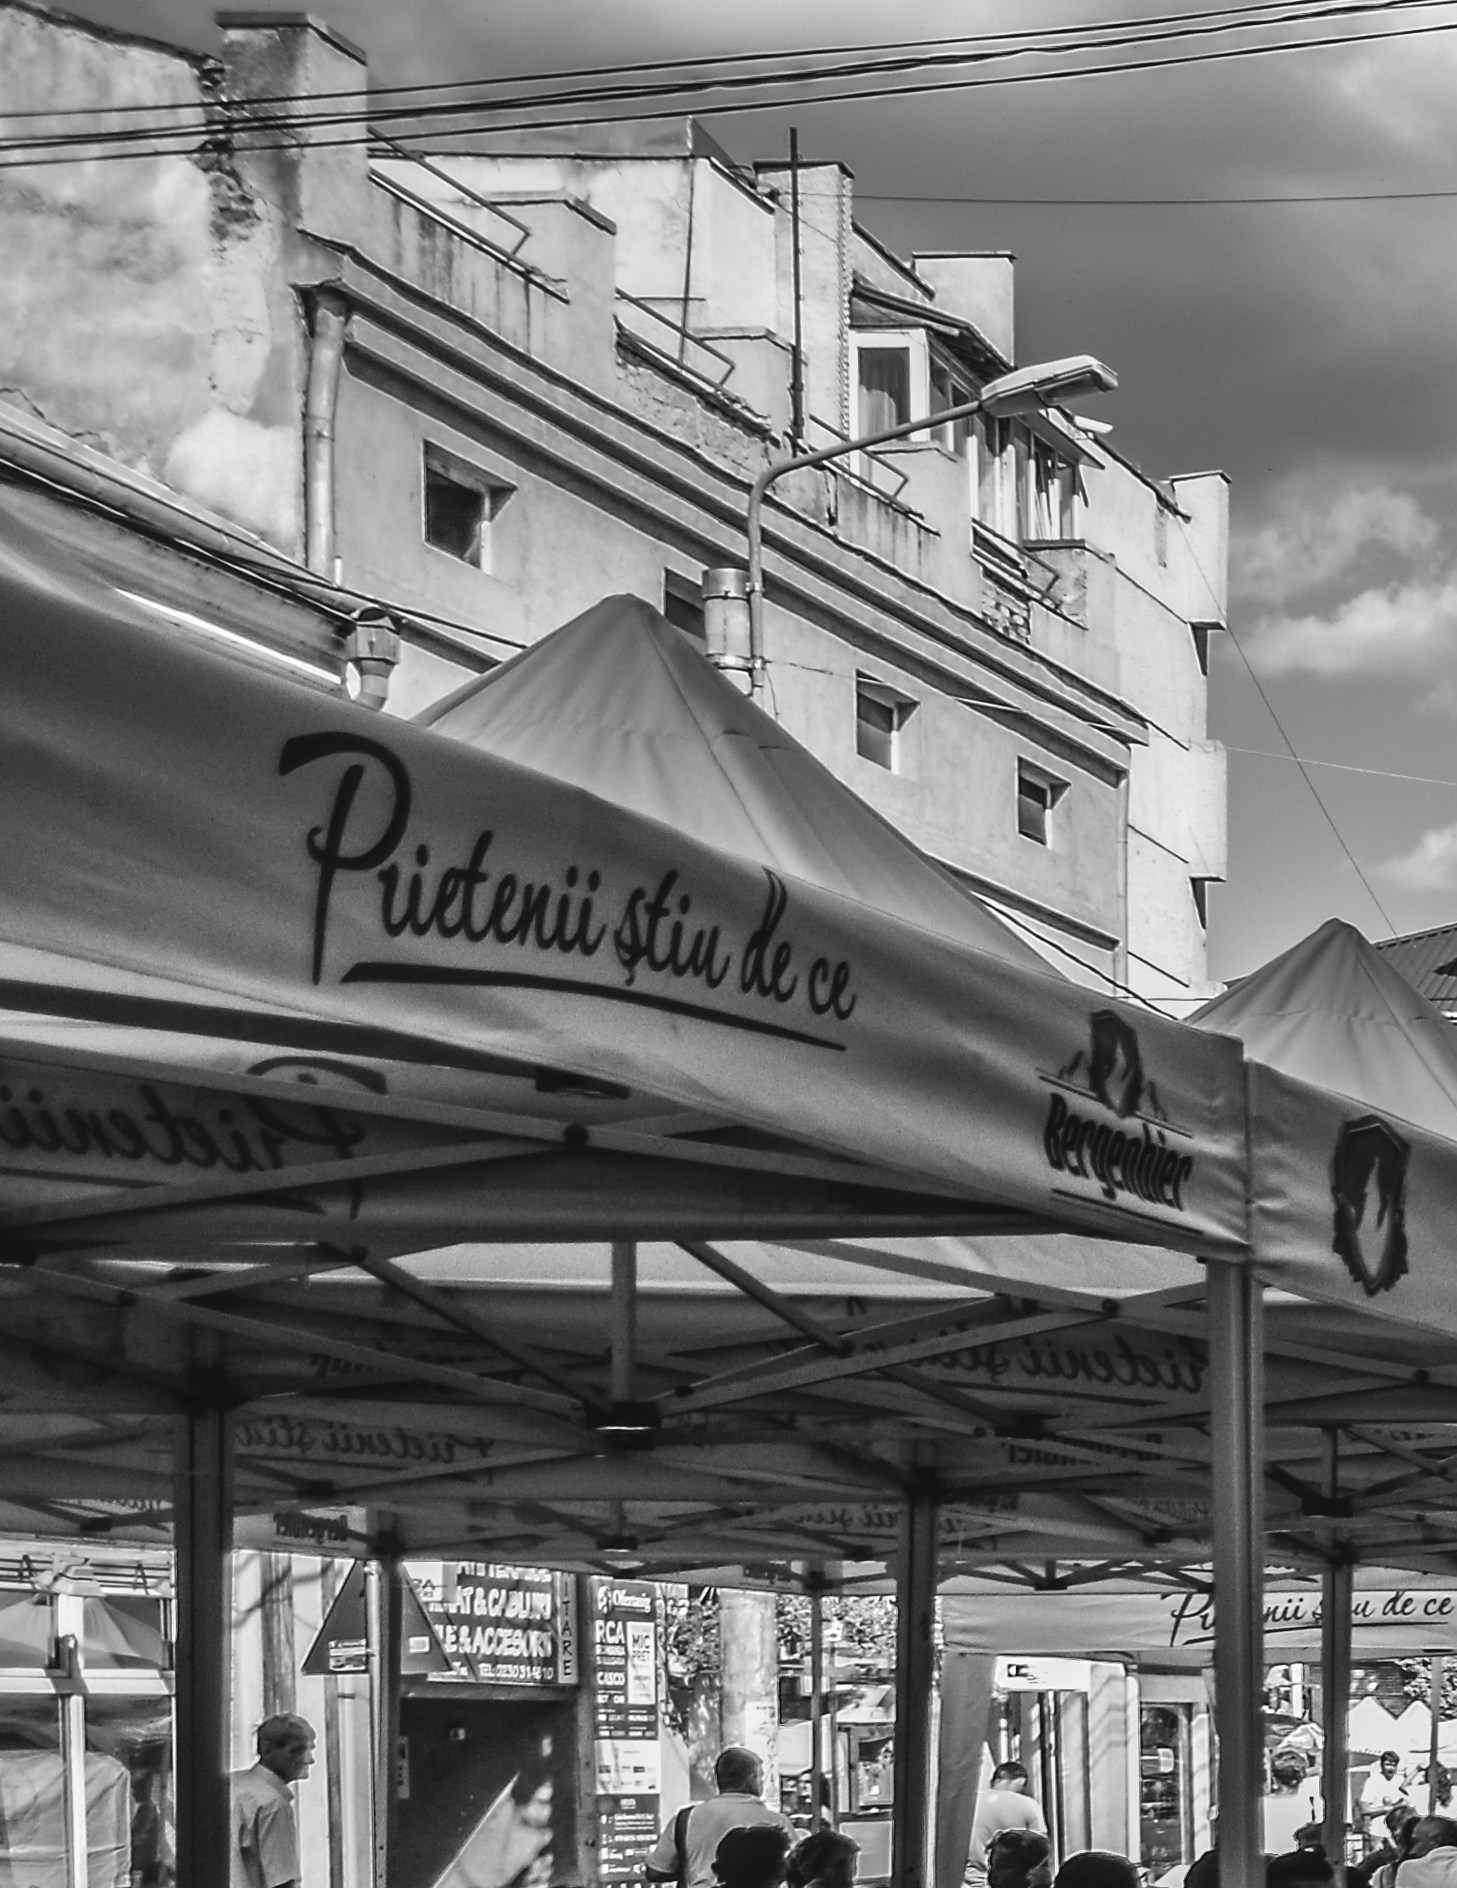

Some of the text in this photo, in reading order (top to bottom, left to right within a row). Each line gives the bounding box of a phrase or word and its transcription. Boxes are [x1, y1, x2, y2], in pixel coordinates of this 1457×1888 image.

[278, 731, 607, 986] Prietenii
[742, 865, 797, 1002] de
[809, 955, 857, 1022] ce
[1044, 1092, 1193, 1211] Bergenbier
[595, 1620, 626, 1645] RCA
[1382, 1590, 1456, 1616] de ce
